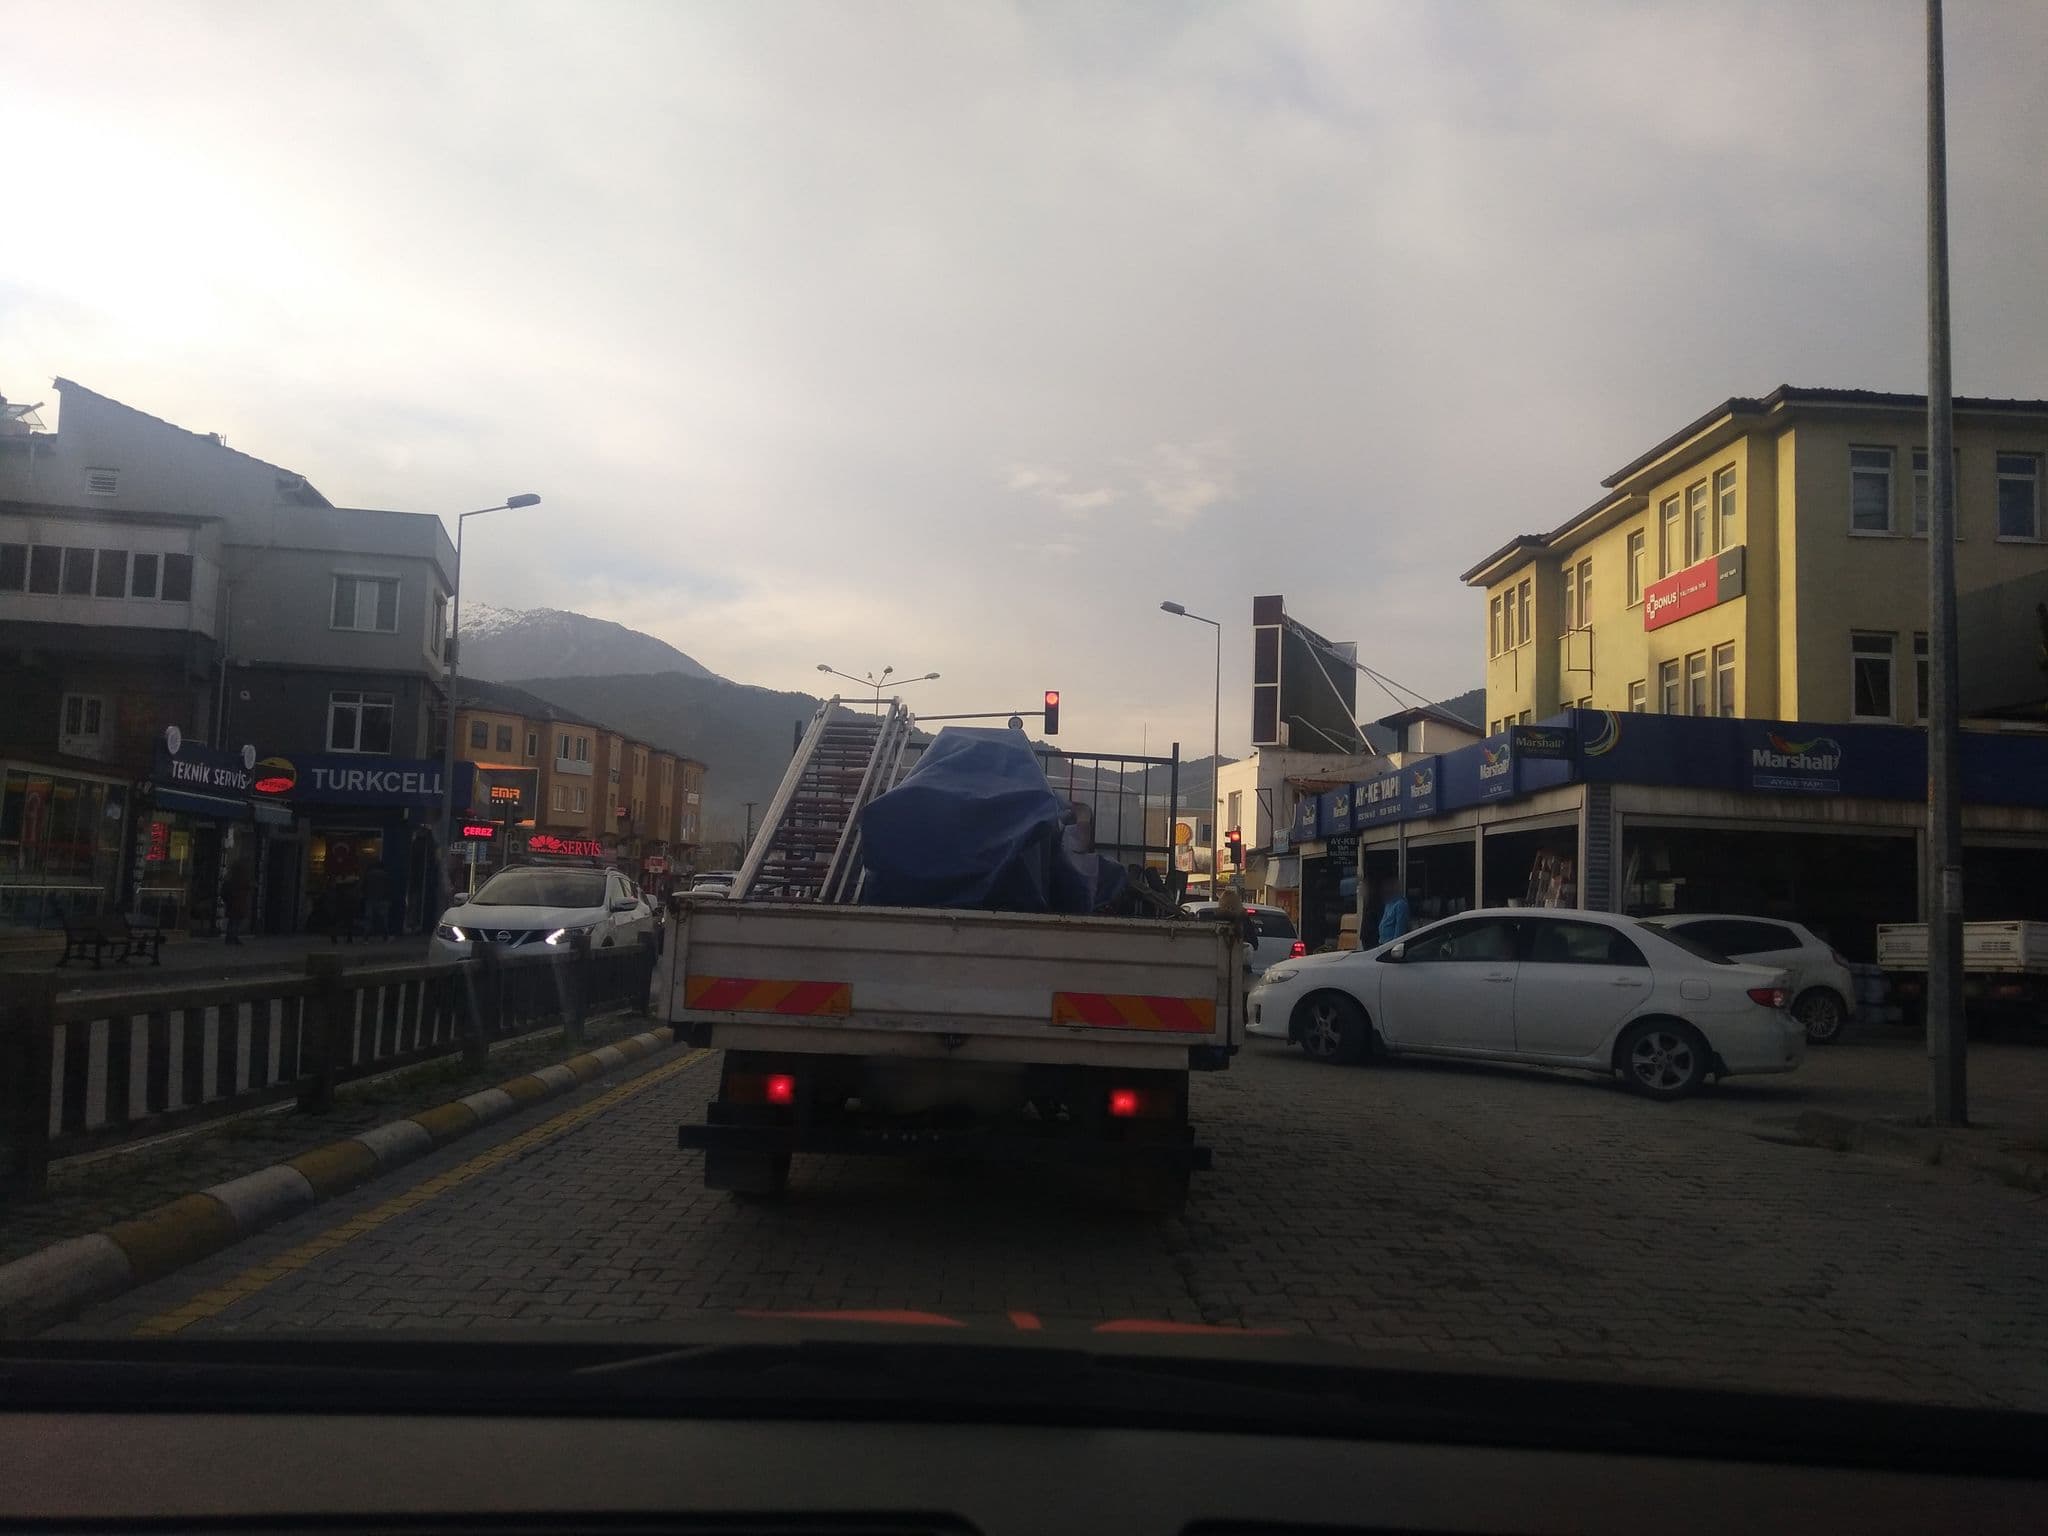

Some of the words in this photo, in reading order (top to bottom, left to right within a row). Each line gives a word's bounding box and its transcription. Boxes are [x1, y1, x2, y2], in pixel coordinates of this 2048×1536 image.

[1653, 592, 1677, 611] BONUS
[1516, 737, 1561, 748] Marshall
[1480, 759, 1510, 780] Marshall
[1752, 749, 1833, 770] Marshall
[172, 759, 210, 784] TEKNİK
[214, 768, 248, 790] SERVİS
[311, 768, 446, 794] TURKCELL
[463, 826, 494, 837] ÇEREZ
[561, 840, 601, 857] SERVİS
